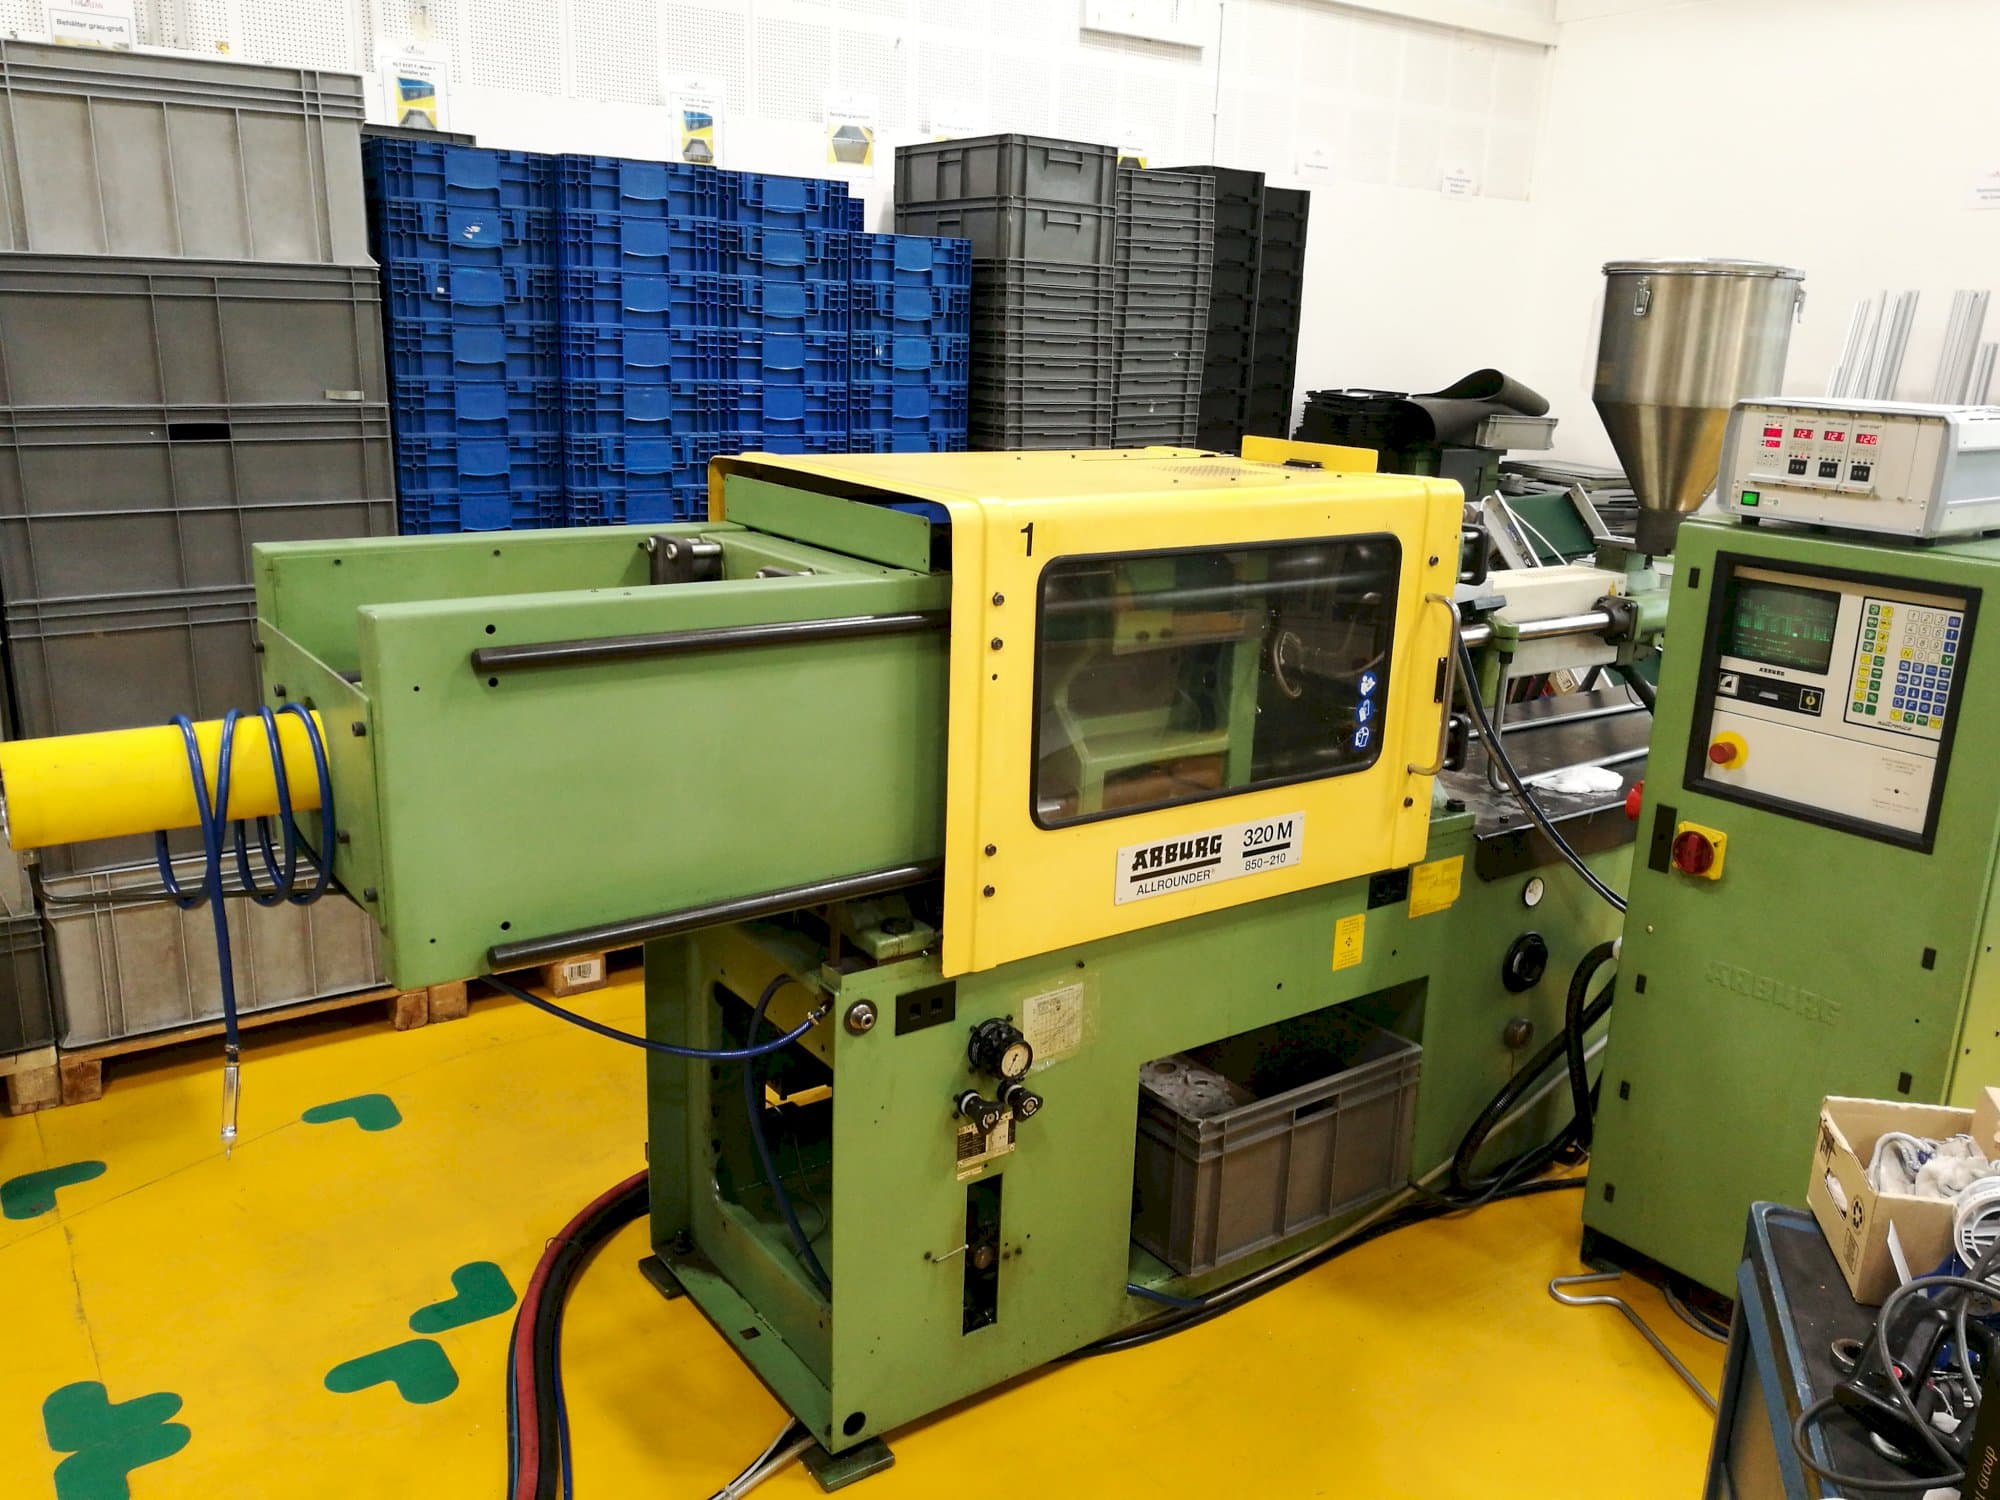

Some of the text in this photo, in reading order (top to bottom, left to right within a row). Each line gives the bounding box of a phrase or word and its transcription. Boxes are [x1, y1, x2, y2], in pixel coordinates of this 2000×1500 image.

[1020, 522, 1034, 557] 1
[1131, 821, 1293, 871] ARBURG 320 M
[1245, 853, 1286, 871] 850-210
[1978, 1446, 1998, 1489] Group
